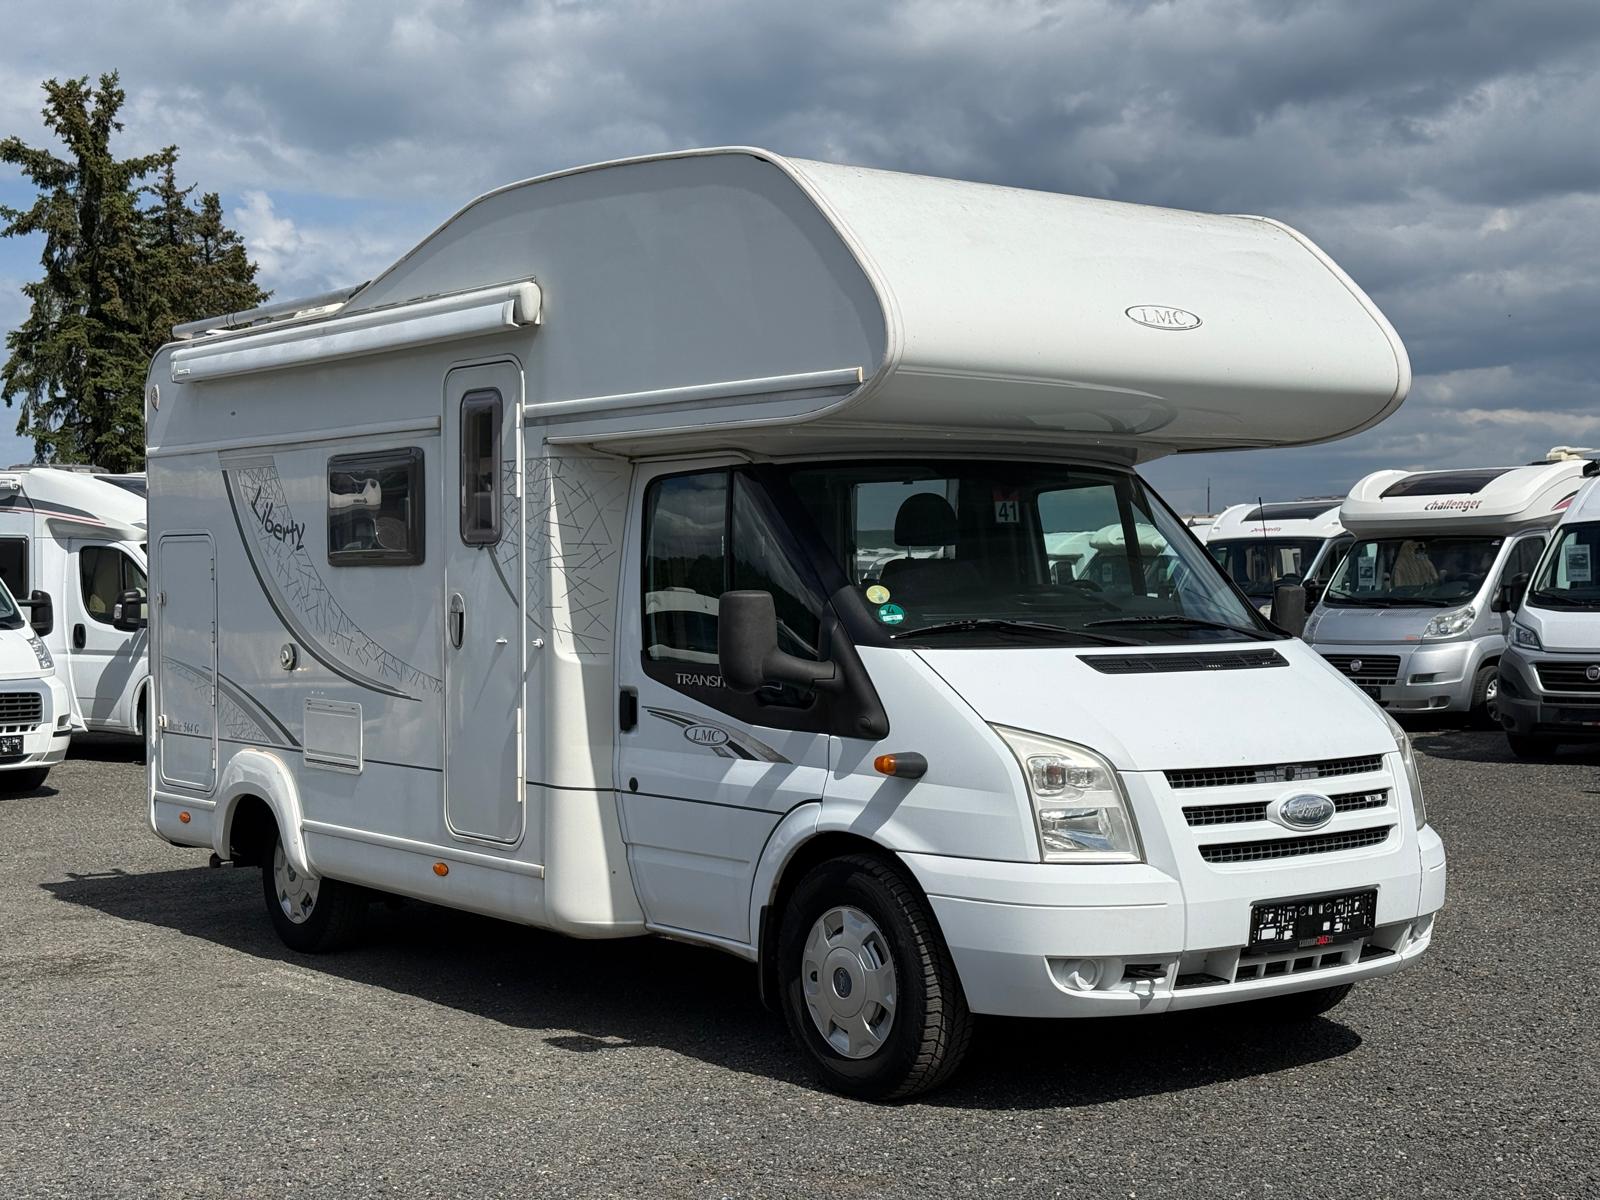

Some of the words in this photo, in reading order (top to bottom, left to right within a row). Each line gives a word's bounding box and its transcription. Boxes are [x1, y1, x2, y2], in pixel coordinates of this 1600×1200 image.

[1140, 308, 1186, 325] LMC
[998, 502, 1017, 521] 41
[1424, 499, 1482, 512] challenger
[250, 485, 305, 551] Liberty
[693, 729, 720, 742] LMC
[1294, 800, 1326, 818] Ford
